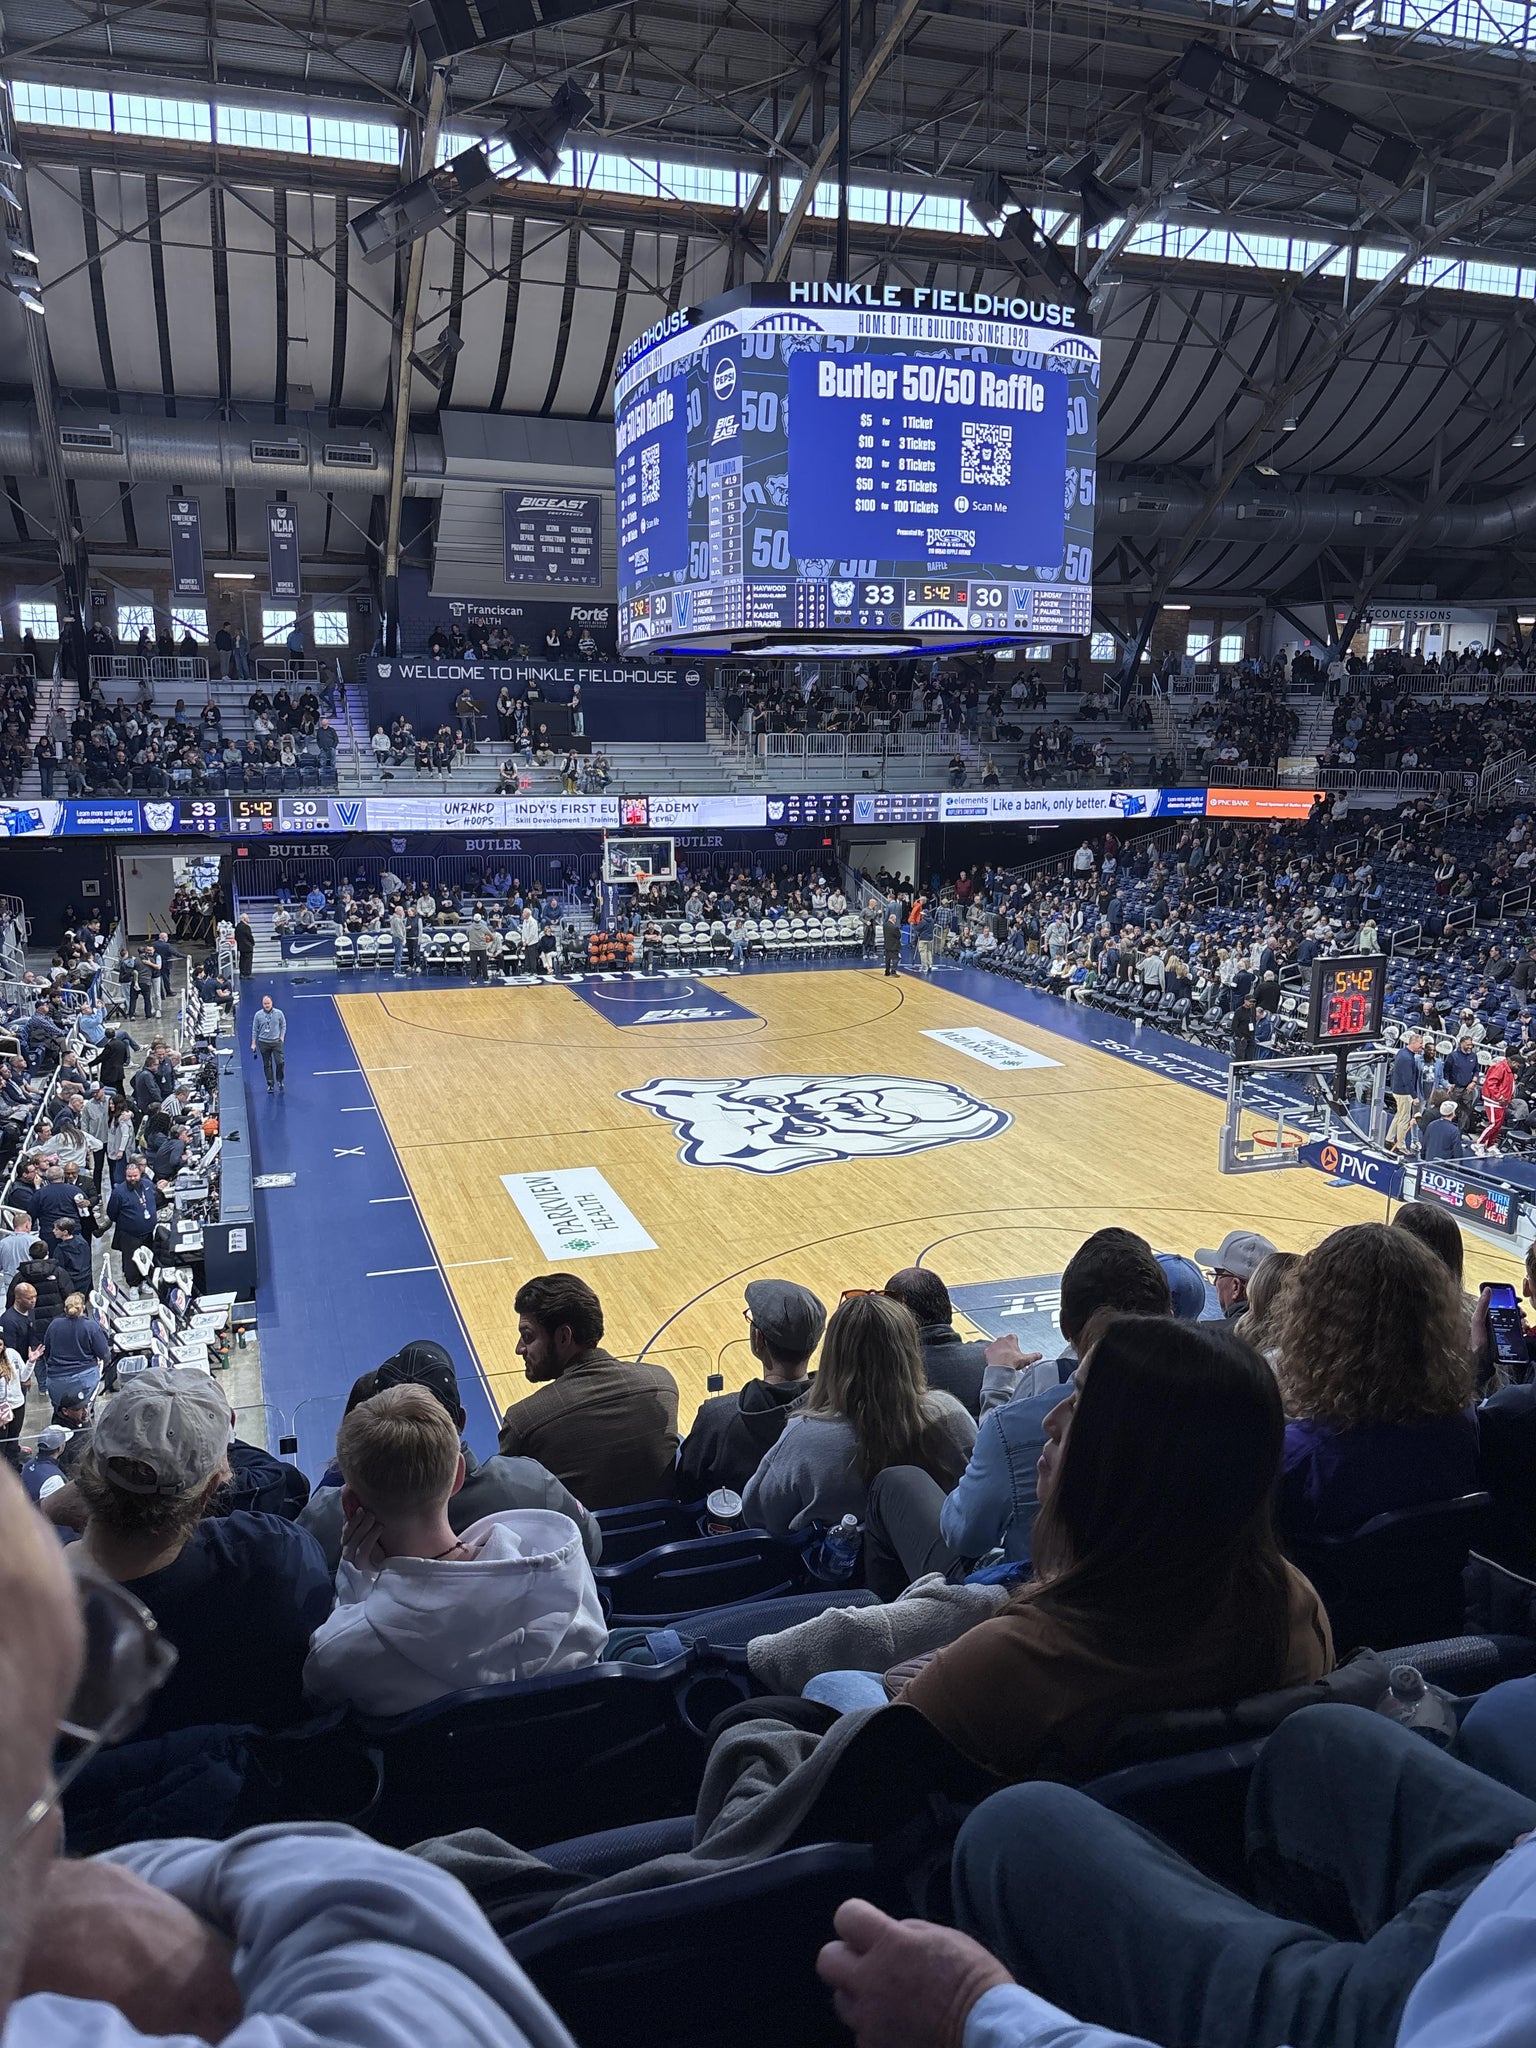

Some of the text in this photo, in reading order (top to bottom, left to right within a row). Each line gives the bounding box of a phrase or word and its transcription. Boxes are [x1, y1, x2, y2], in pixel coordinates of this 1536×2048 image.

[790, 281, 1076, 328] HINKLE FIELDHOUSE
[627, 306, 690, 365] FIELDHOUSE
[859, 313, 1030, 349] HOME OF THE BULLDOGS SINCE 1928
[715, 373, 735, 386] PEPSI
[819, 360, 1045, 413] Butler 50/50 Raffle
[647, 388, 675, 432] Raffle
[716, 415, 736, 427] BIG
[860, 413, 934, 431] $5 for Ticket
[713, 424, 740, 439] EAST
[858, 434, 937, 452] $10 for 3 Tickets
[855, 455, 936, 473] $20 for 8 Tickets
[856, 477, 938, 494] $50 for 25 Tickets
[855, 498, 939, 515] $100 for 100 Tickets
[972, 500, 1008, 513] Scan Me
[271, 519, 295, 533] NCAA
[926, 528, 977, 549] BROTHERS
[752, 527, 791, 570] 50
[689, 541, 710, 580] 50
[1065, 543, 1093, 583] 50
[865, 585, 895, 605] 33
[908, 590, 916, 601] 2
[924, 585, 951, 600] 5:42
[957, 592, 967, 602] 30
[976, 588, 1003, 607] 30
[467, 603, 523, 616] Franciscan
[655, 596, 667, 615] 30
[571, 606, 609, 621] Forté
[876, 616, 883, 625] 3
[1375, 609, 1452, 620] CONCESSIONS
[753, 620, 782, 628] TRAORE
[987, 619, 993, 627] 3
[999, 619, 1006, 627] 0
[399, 664, 485, 680] WELCOME
[489, 666, 513, 680] TO
[516, 667, 575, 682] HINKLE
[579, 669, 677, 684] FIELDHOUSE
[239, 801, 273, 816] 5:42
[292, 801, 317, 816] 30
[514, 802, 558, 815] INDY'S
[561, 802, 597, 815] FIRST
[954, 797, 989, 805] elements
[993, 796, 1107, 812] Like a bank, only better.
[1231, 799, 1250, 807] BANK
[77, 809, 91, 817] Learn
[104, 809, 114, 817] and
[114, 809, 127, 818] apply
[191, 802, 217, 817] 33
[444, 802, 496, 816] UNRNKD
[78, 817, 134, 825] elements.org/Butler
[240, 822, 247, 831] 2
[463, 815, 495, 828] HOOPS
[515, 816, 531, 824] Skill
[533, 816, 580, 825] Development
[591, 816, 619, 825] Training
[465, 838, 522, 851] BUTLER
[674, 835, 724, 848] BUTLER
[269, 844, 330, 857] BUTLER
[498, 967, 741, 986] BUTLER
[1335, 968, 1374, 994] 5:42
[1329, 994, 1367, 1036] 30
[1340, 1152, 1379, 1186] PNC
[1420, 1170, 1465, 1196] HOPE
[1487, 1189, 1511, 1207] TURN
[522, 1176, 588, 1236] PARKVIEW
[573, 1194, 619, 1231] HEALTH
[1485, 1200, 1509, 1217] UP THE
[1484, 1210, 1508, 1225] HEAT
